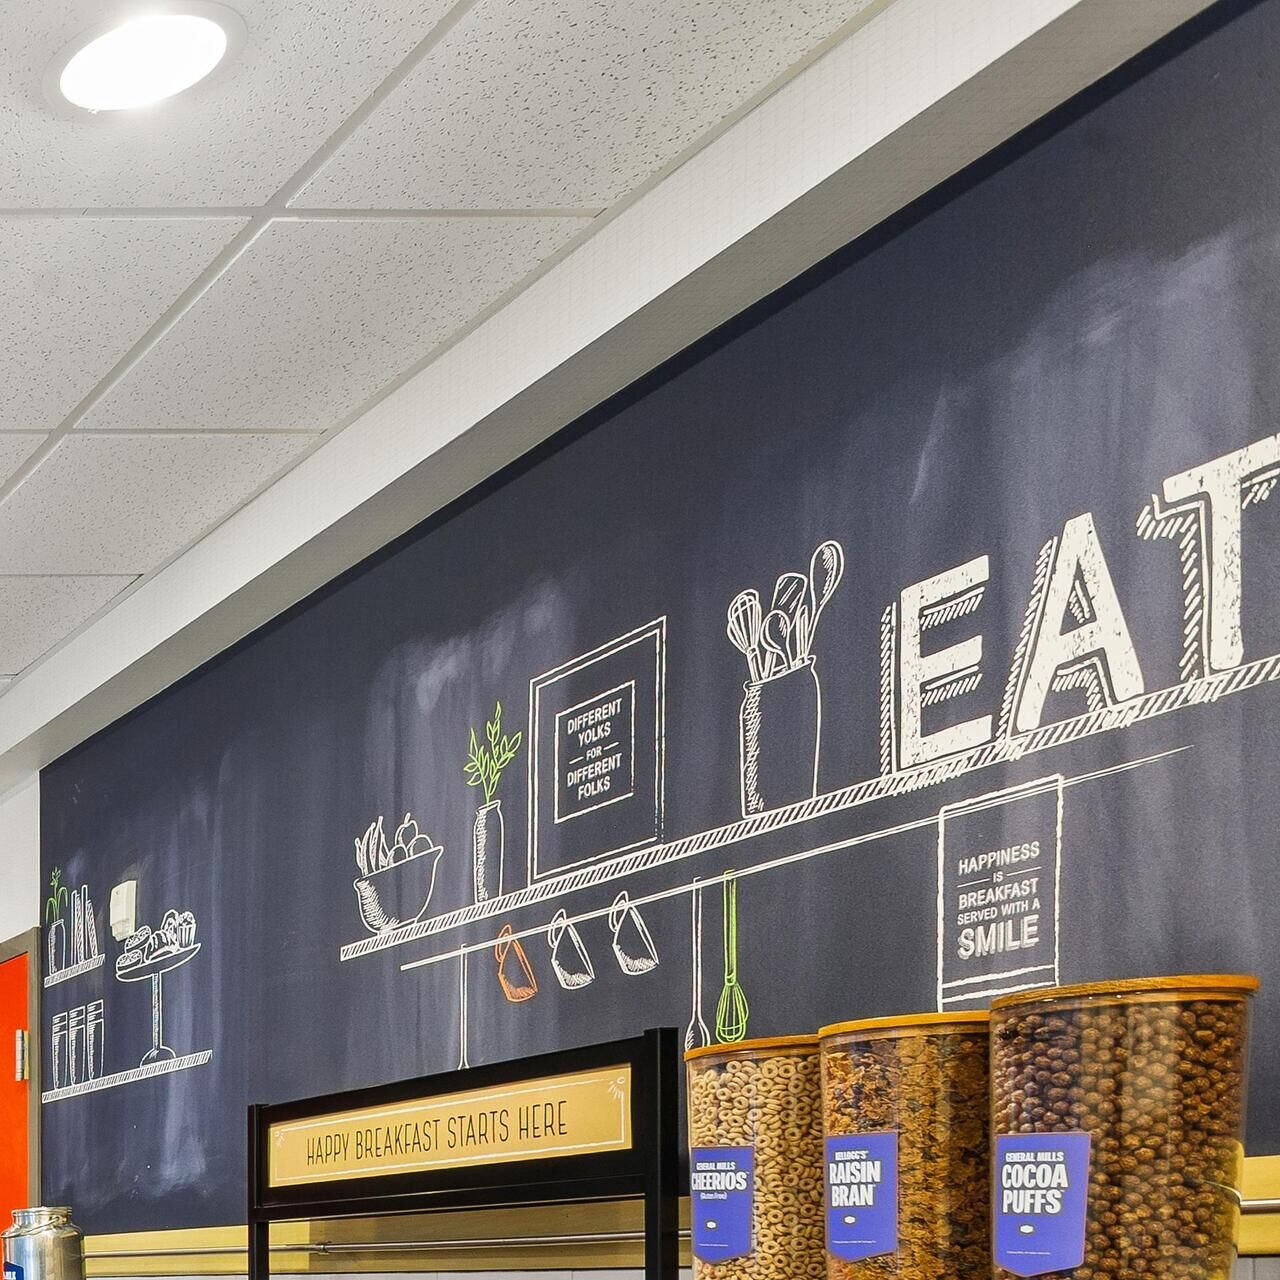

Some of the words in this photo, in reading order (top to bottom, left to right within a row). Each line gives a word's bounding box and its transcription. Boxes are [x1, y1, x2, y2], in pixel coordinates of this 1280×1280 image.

[881, 432, 1280, 774] EAT
[567, 698, 622, 735] DIFFERENT
[578, 721, 611, 747] YOLKS
[586, 745, 602, 761] FOR
[567, 752, 622, 787] DIFFERENT
[578, 775, 610, 800] FOLKS
[958, 841, 1040, 876] HAPPINESS
[992, 871, 1004, 883] IS
[958, 877, 1039, 911] BREAKFAST
[957, 907, 998, 926] SERVED
[1001, 899, 1029, 917] WITH
[1032, 897, 1041, 911] A
[957, 914, 1040, 960] SMILE
[307, 1133, 349, 1166] HAPPY
[356, 1119, 440, 1160] BREAKFAST
[447, 1109, 509, 1149] STARTS
[518, 1100, 568, 1140] HERE
[1003, 1152, 1036, 1163] GENERAL
[1037, 1151, 1065, 1162] MILLS
[691, 1171, 748, 1191] CHEERIOS
[829, 1160, 881, 1185] RAISIN
[1002, 1163, 1069, 1189] COCOA
[831, 1183, 874, 1207] BRAN
[1002, 1188, 1062, 1214] PUFFS
